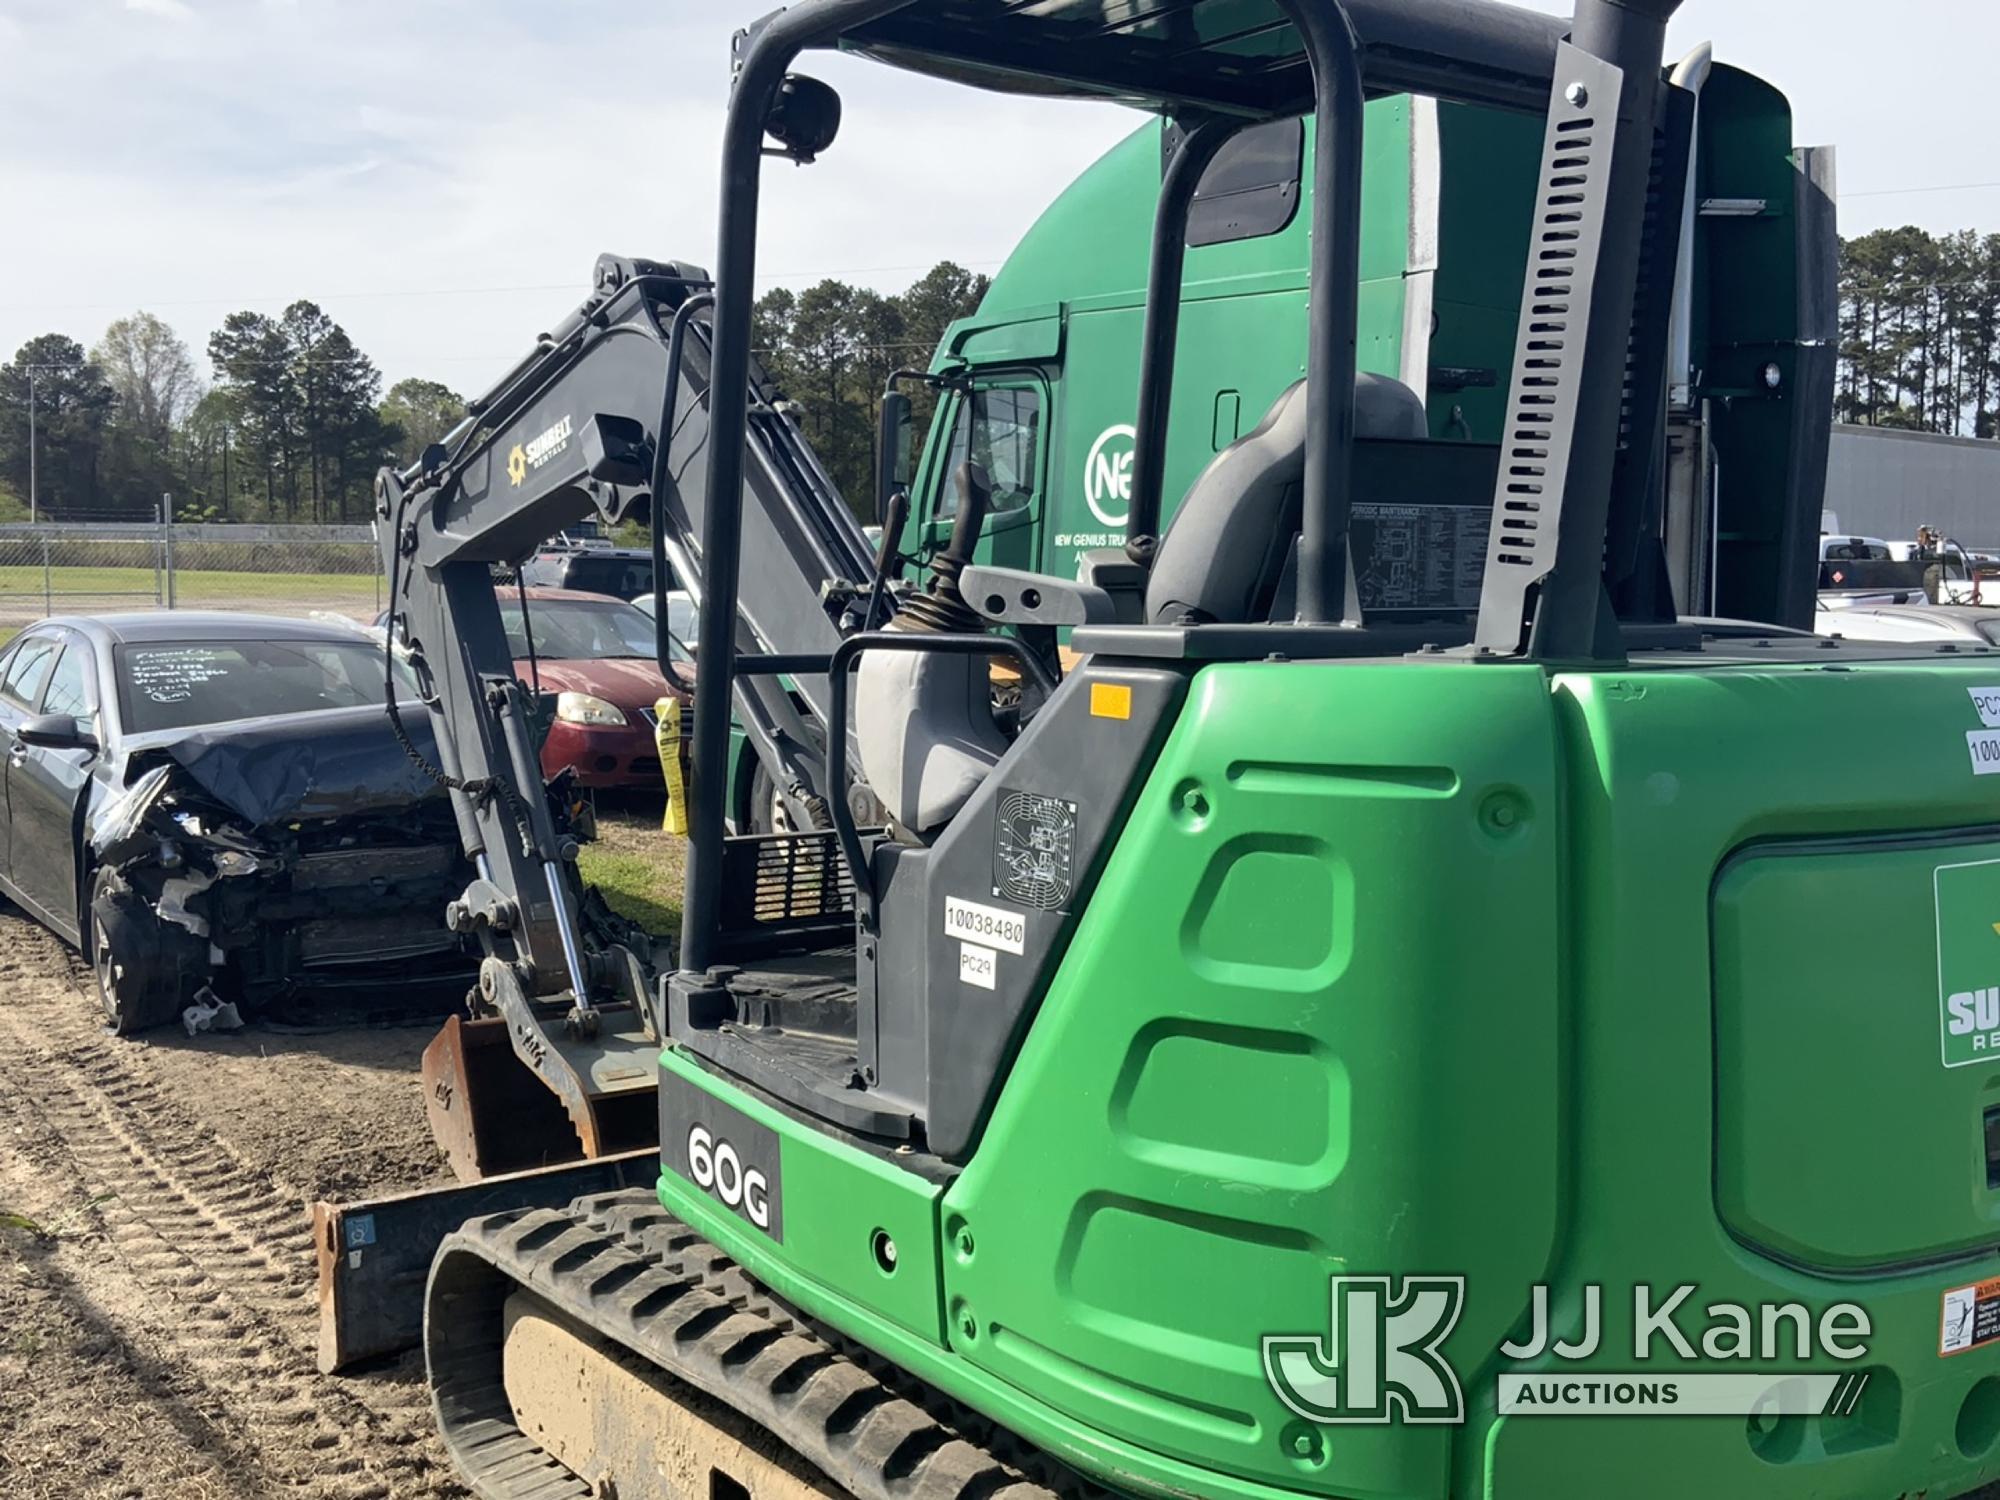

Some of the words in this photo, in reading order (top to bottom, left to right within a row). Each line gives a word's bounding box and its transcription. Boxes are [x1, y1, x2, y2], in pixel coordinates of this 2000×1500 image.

[526, 414, 572, 464] SUNBELT
[533, 440, 567, 469] RENTALS
[1055, 534, 1072, 547] NEW
[1073, 534, 1106, 547] GENIUS
[1971, 740, 2000, 762] 100
[947, 907, 1023, 943] 10038480
[961, 954, 992, 975] PC29
[688, 1125, 769, 1229] 60G
